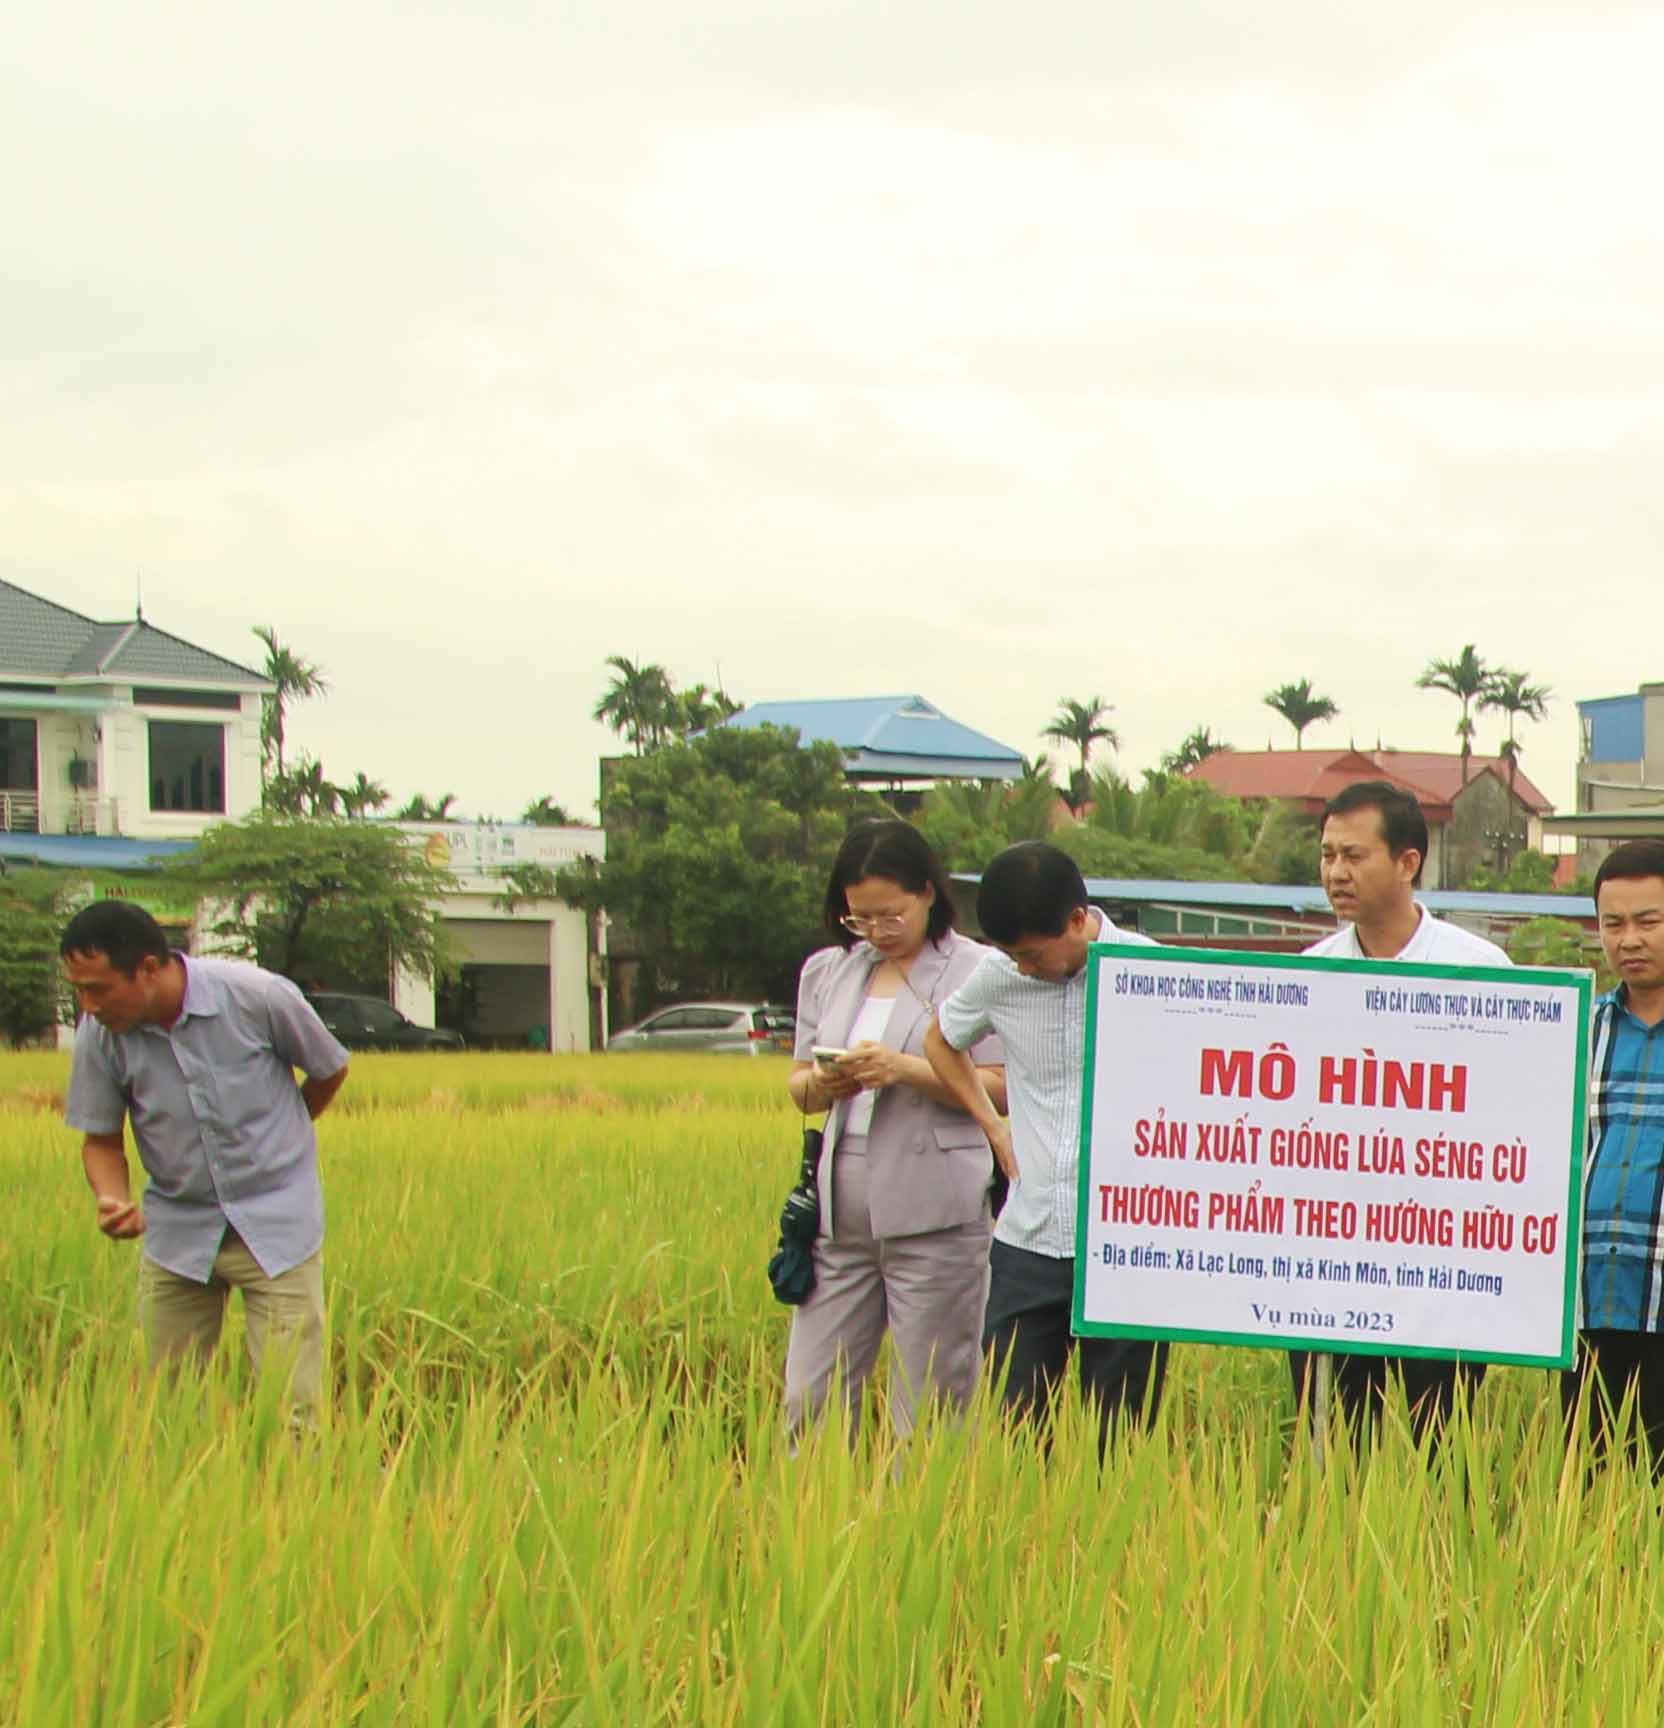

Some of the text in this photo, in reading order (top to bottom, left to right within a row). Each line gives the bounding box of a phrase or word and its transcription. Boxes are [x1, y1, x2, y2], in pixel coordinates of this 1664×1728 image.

[1130, 975, 1155, 995] KHOA
[1157, 976, 1175, 1002] HỌC
[1178, 974, 1205, 999] CÔNG
[1277, 983, 1309, 1006] DƯƠNG
[1389, 987, 1408, 1013] CÂY
[1410, 991, 1441, 1015] LƯƠNG
[1444, 993, 1468, 1021] THỰC
[1470, 992, 1483, 1018] VÀ
[1507, 997, 1531, 1025] THỰC
[1199, 1042, 1467, 1112] MÔ HÌNH
[1134, 1106, 1527, 1184] SẢN XUẤT GIỐNG LÚA SÉNG CÙ
[1099, 1179, 1558, 1255] THƯƠNG PHẨM THEO HƯỚNG HỮU CƠ
[1103, 1241, 1503, 1296] Địa điểm: Xã Lạc Long, thị xã Kinh Môn, tỉnh Hải Dương
[1251, 1303, 1394, 1332] Vụ mùa 2023
